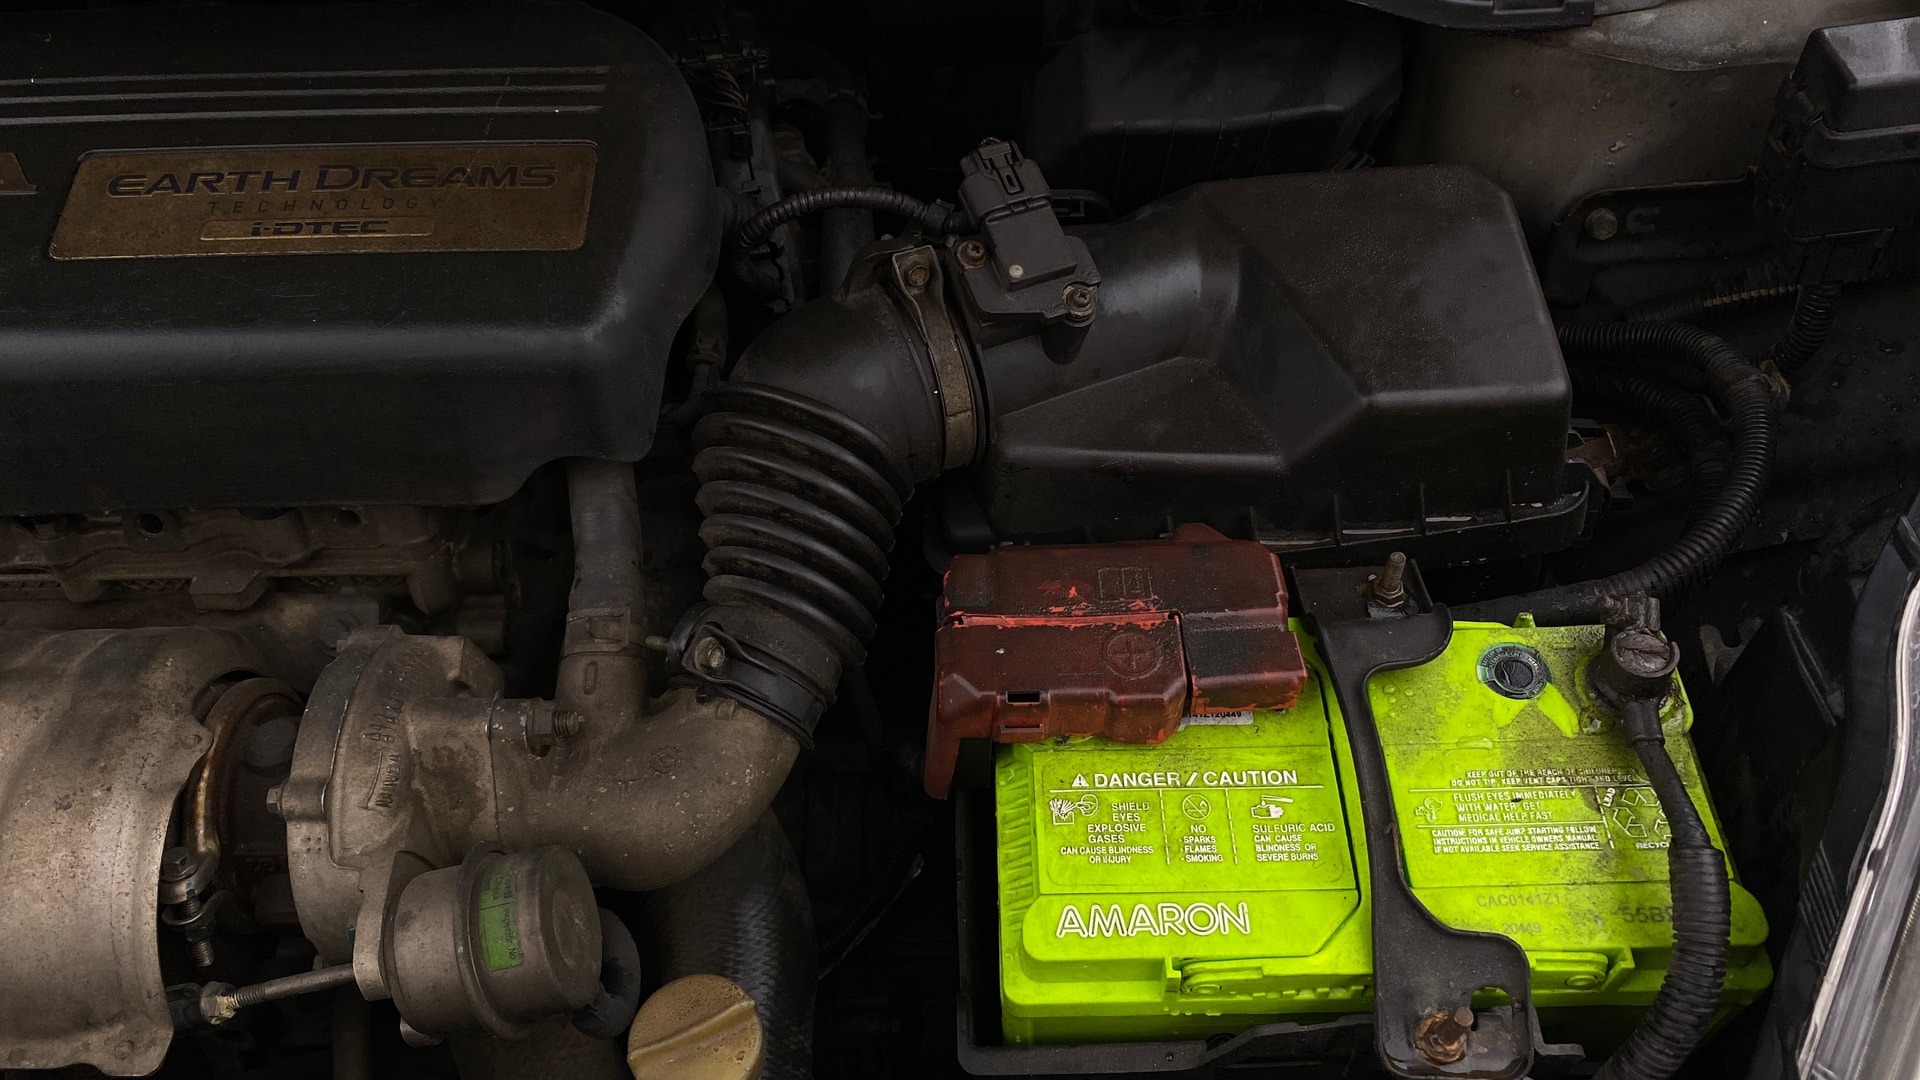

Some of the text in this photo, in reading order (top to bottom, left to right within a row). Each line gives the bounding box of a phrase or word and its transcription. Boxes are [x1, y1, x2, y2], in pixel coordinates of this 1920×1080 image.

[107, 164, 559, 198] EARTH DREAMS
[209, 197, 444, 214] TECHNOLOGY
[251, 220, 389, 236] i-DTEC
[1094, 770, 1298, 788] DANGER / CAUTION
[1466, 770, 1486, 779] KEEP
[1488, 770, 1505, 778] OUT
[1507, 769, 1517, 778] OF
[1519, 769, 1536, 777] THE
[1537, 768, 1563, 777] REACH
[1451, 779, 1463, 787] DO
[1465, 779, 1481, 787] NOT
[1501, 777, 1521, 786] KEEP
[1546, 776, 1566, 784] CAPS
[1453, 789, 1577, 802] FLUSH EYES IMMEDIATELY
[1601, 787, 1616, 807] LEAD
[1111, 802, 1150, 811] SHIELD
[1456, 803, 1483, 813] WITH
[1522, 801, 1541, 811] GET
[1112, 812, 1141, 822] EYES
[1458, 811, 1553, 823] MEDICAL HELP FAST
[1087, 823, 1147, 833] EXPLOSIVE
[1190, 825, 1207, 833] NO
[1253, 823, 1336, 834] SULFURIC ACID
[1468, 829, 1484, 837] FOR
[1485, 828, 1504, 836] SAFE
[1505, 827, 1526, 836] JUMP
[1527, 826, 1564, 835] STARTING
[1565, 825, 1598, 834] FOLLOW
[1088, 834, 1125, 844] GASES
[1183, 835, 1217, 844] SPARKS
[1253, 834, 1303, 843] CAN CAUSE
[1433, 837, 1488, 846] INSTRUCTIONS
[1489, 837, 1498, 845] IN
[1499, 836, 1530, 845] VEHICLE
[1531, 835, 1565, 844] OWNERS
[1060, 845, 1154, 856] CAN CAUSE BLINDNESS
[1184, 844, 1217, 853] FLAMES
[1255, 843, 1317, 852] BLINDNESS OR
[1434, 846, 1441, 854] IF
[1442, 846, 1459, 854] NOT
[1460, 845, 1500, 853] AVAILABLE
[1502, 844, 1521, 853] SEEK
[1522, 843, 1553, 852] SERVICE
[1635, 842, 1670, 850] RECYCL
[1089, 855, 1132, 864] OR INJURY
[1185, 853, 1224, 862] SMOKING
[1256, 852, 1319, 862] SEVERE BURNS
[1055, 902, 1251, 939] AMARON
